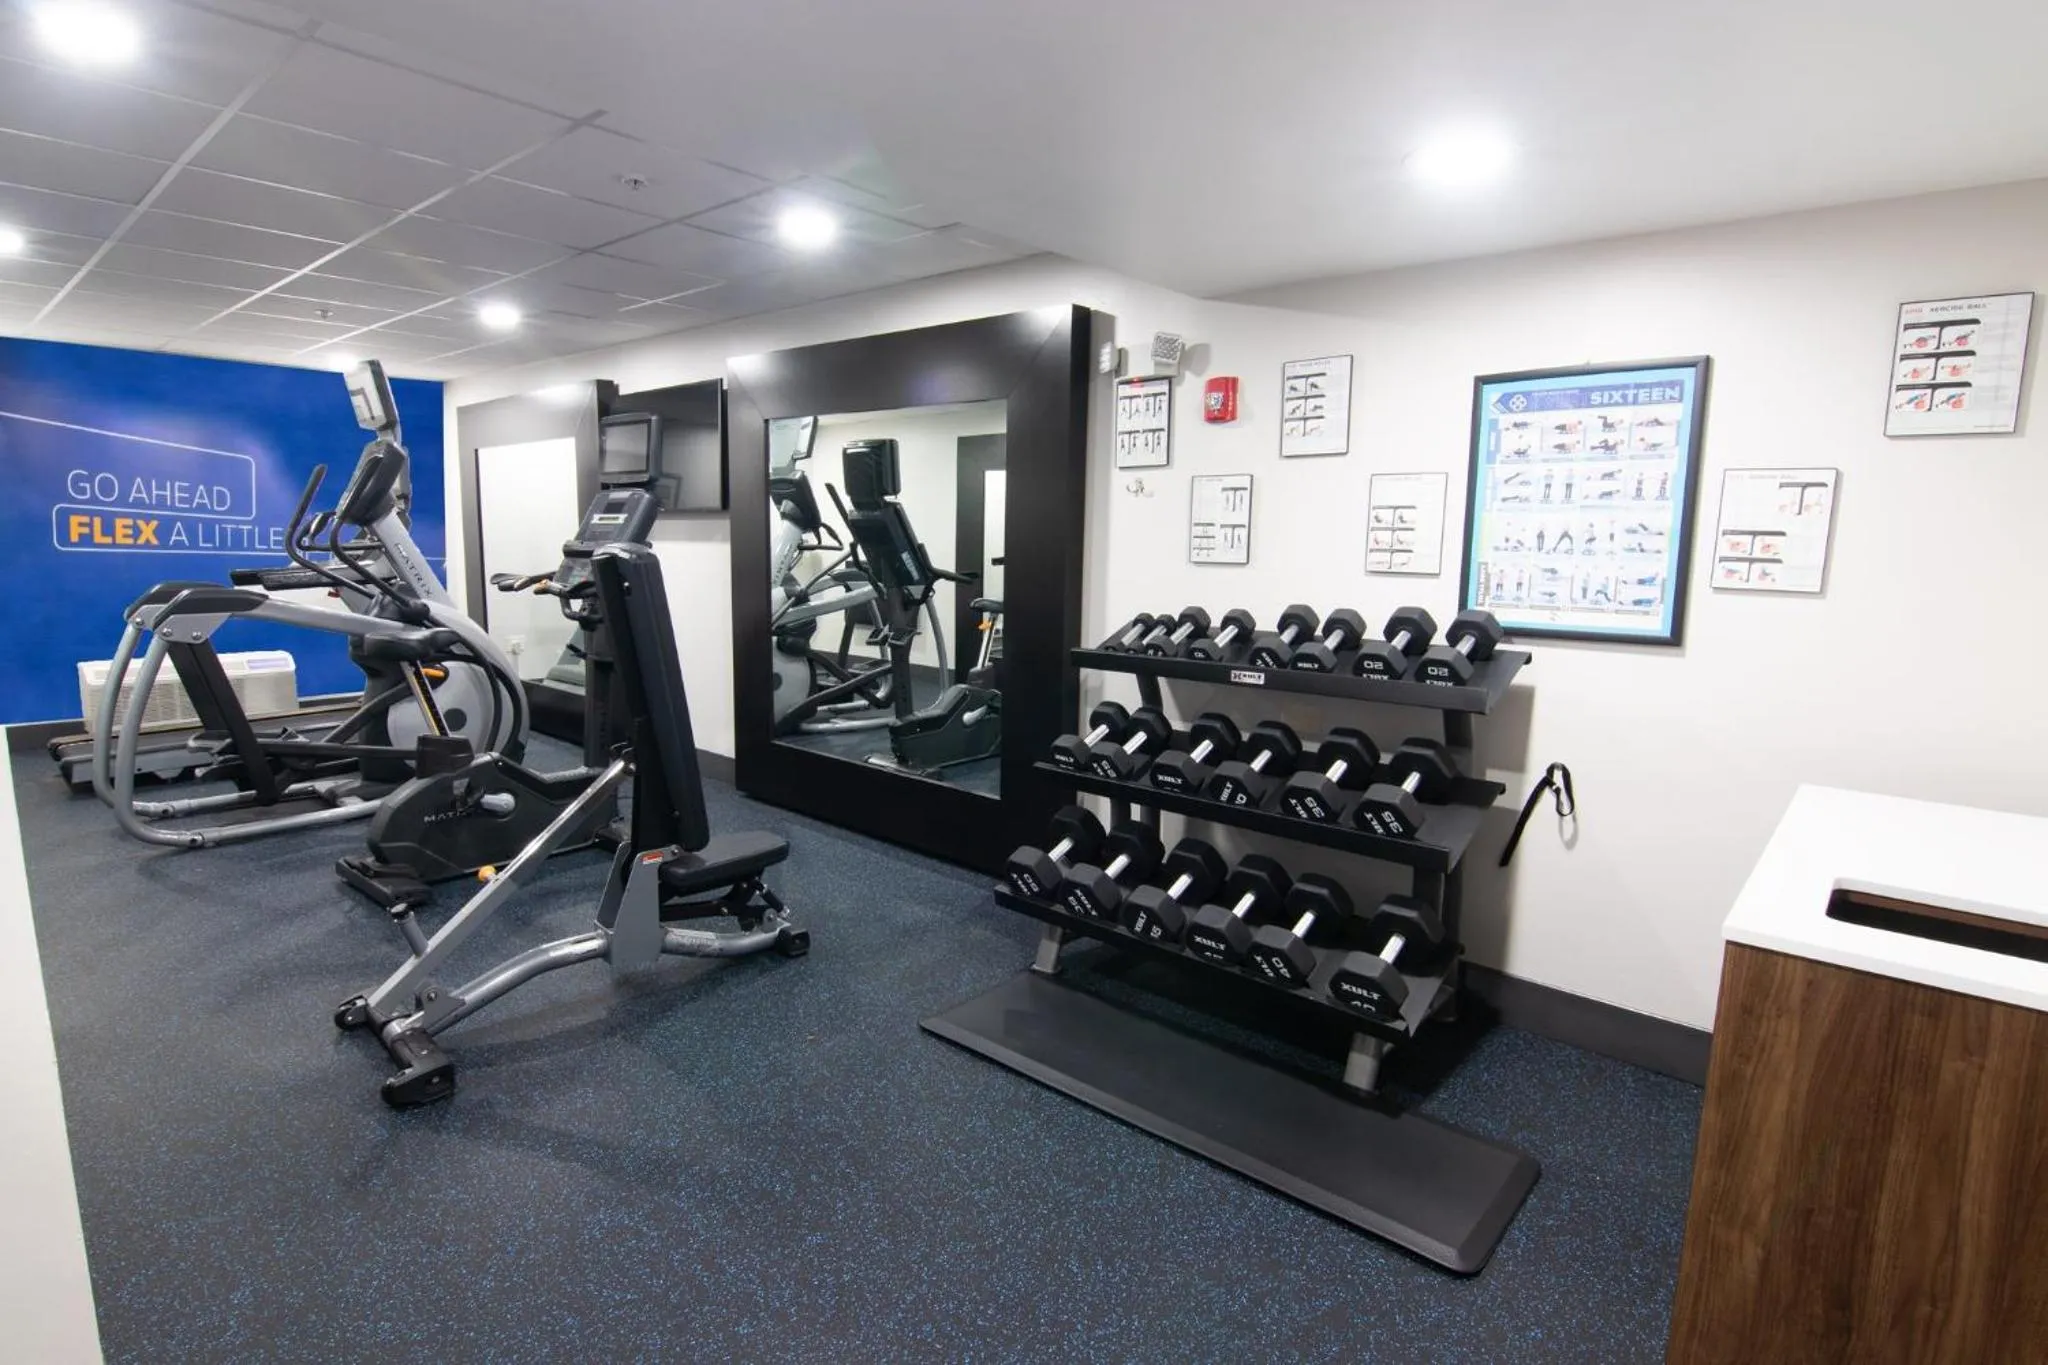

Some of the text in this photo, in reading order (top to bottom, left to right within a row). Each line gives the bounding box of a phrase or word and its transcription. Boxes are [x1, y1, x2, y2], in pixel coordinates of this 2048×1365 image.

[1590, 386, 1680, 405] SIXTEEN
[67, 469, 231, 512] GO AHEAD
[69, 514, 285, 550] FLEX A LITTLE
[1381, 810, 1403, 833] 35
[1194, 934, 1226, 951] XULT
[1340, 981, 1382, 1001] XULT
